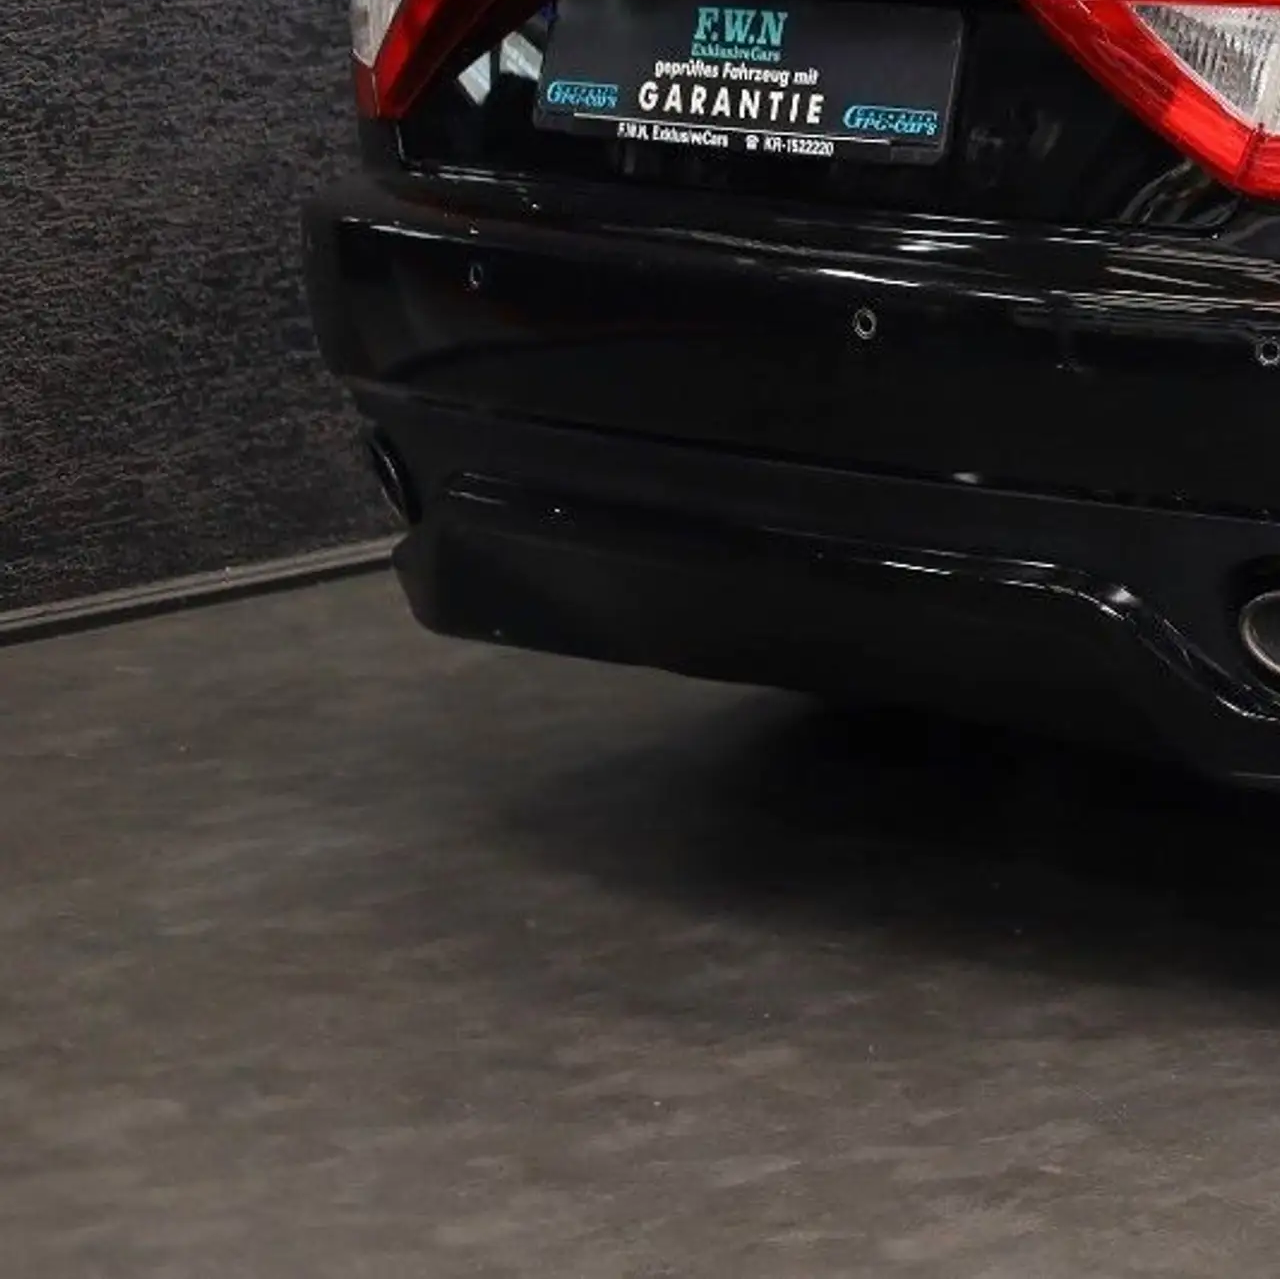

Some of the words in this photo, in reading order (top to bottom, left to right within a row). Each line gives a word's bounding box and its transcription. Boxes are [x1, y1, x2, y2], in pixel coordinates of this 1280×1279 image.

[693, 6, 788, 47] F.W.N
[721, 61, 791, 88] Fahrzeug
[792, 67, 820, 86] mit
[637, 80, 825, 124] GARANTIE
